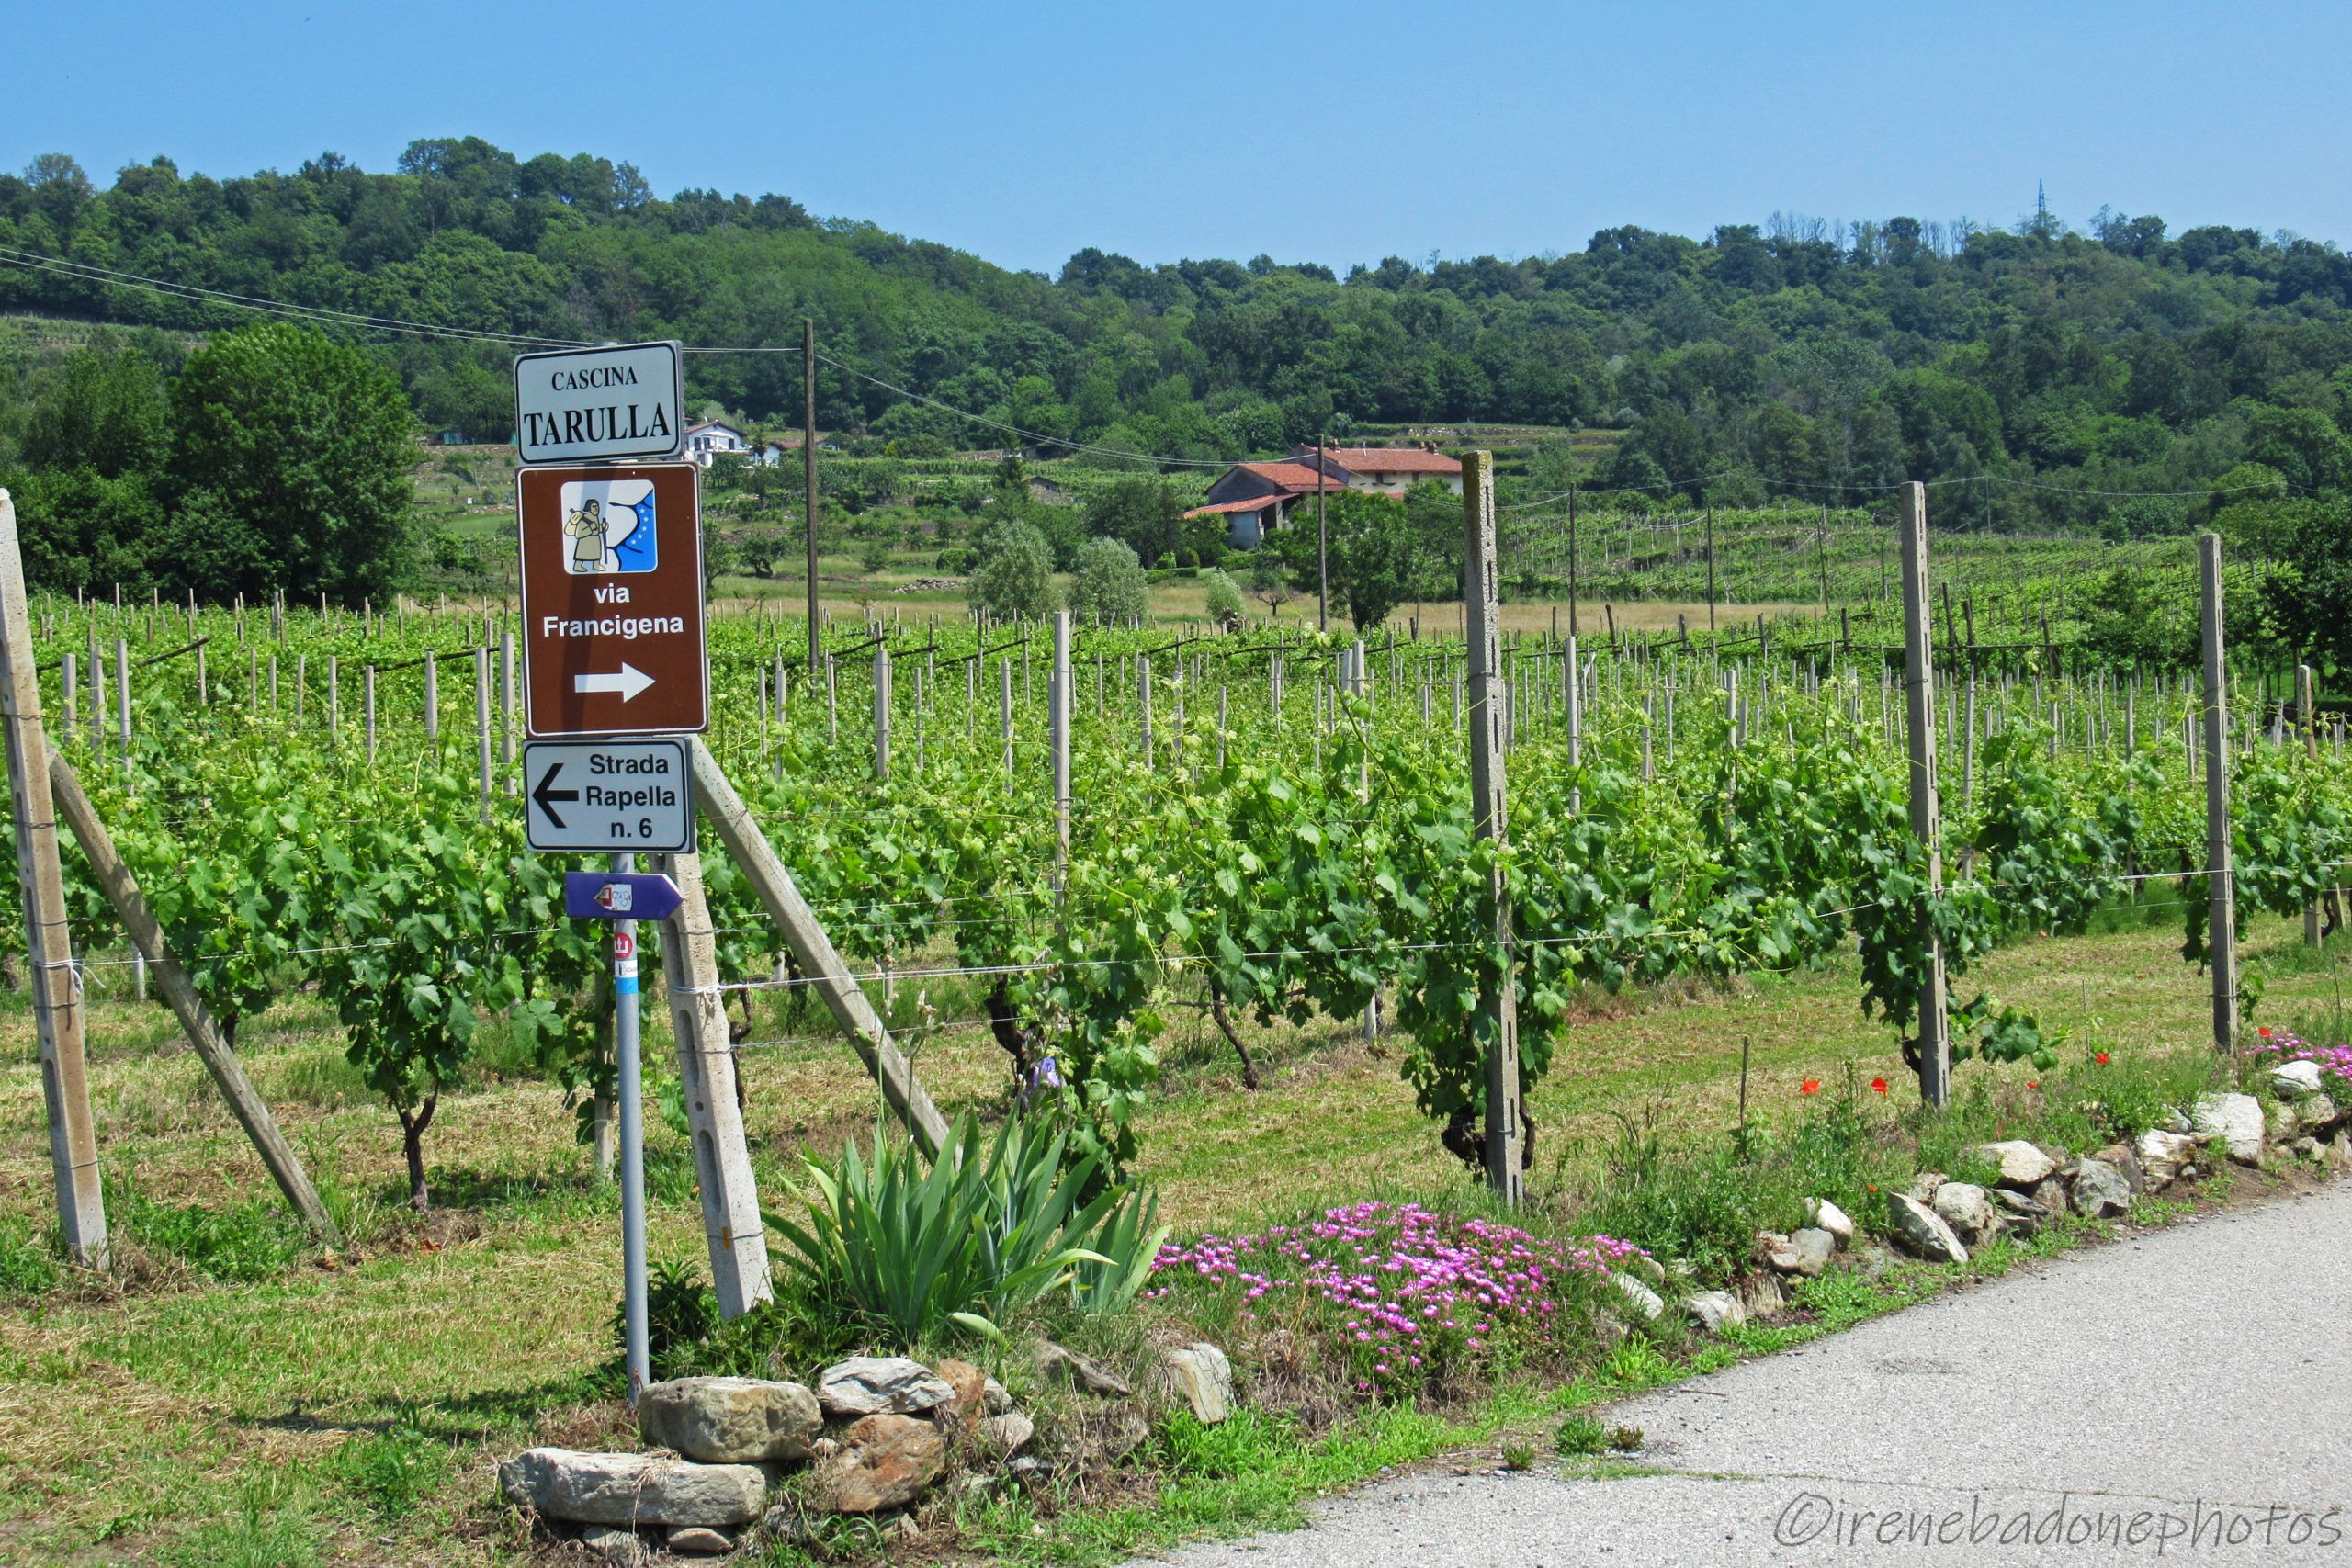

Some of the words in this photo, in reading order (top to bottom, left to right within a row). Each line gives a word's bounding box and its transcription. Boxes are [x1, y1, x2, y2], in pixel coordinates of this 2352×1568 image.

[551, 366, 638, 391] CASCINA
[524, 402, 671, 446] TARULLA
[594, 583, 630, 604] via
[543, 615, 684, 639] Francigena
[590, 754, 669, 774] Strada
[586, 785, 676, 811] Rapella
[610, 821, 632, 838] n.
[639, 818, 653, 838] 6
